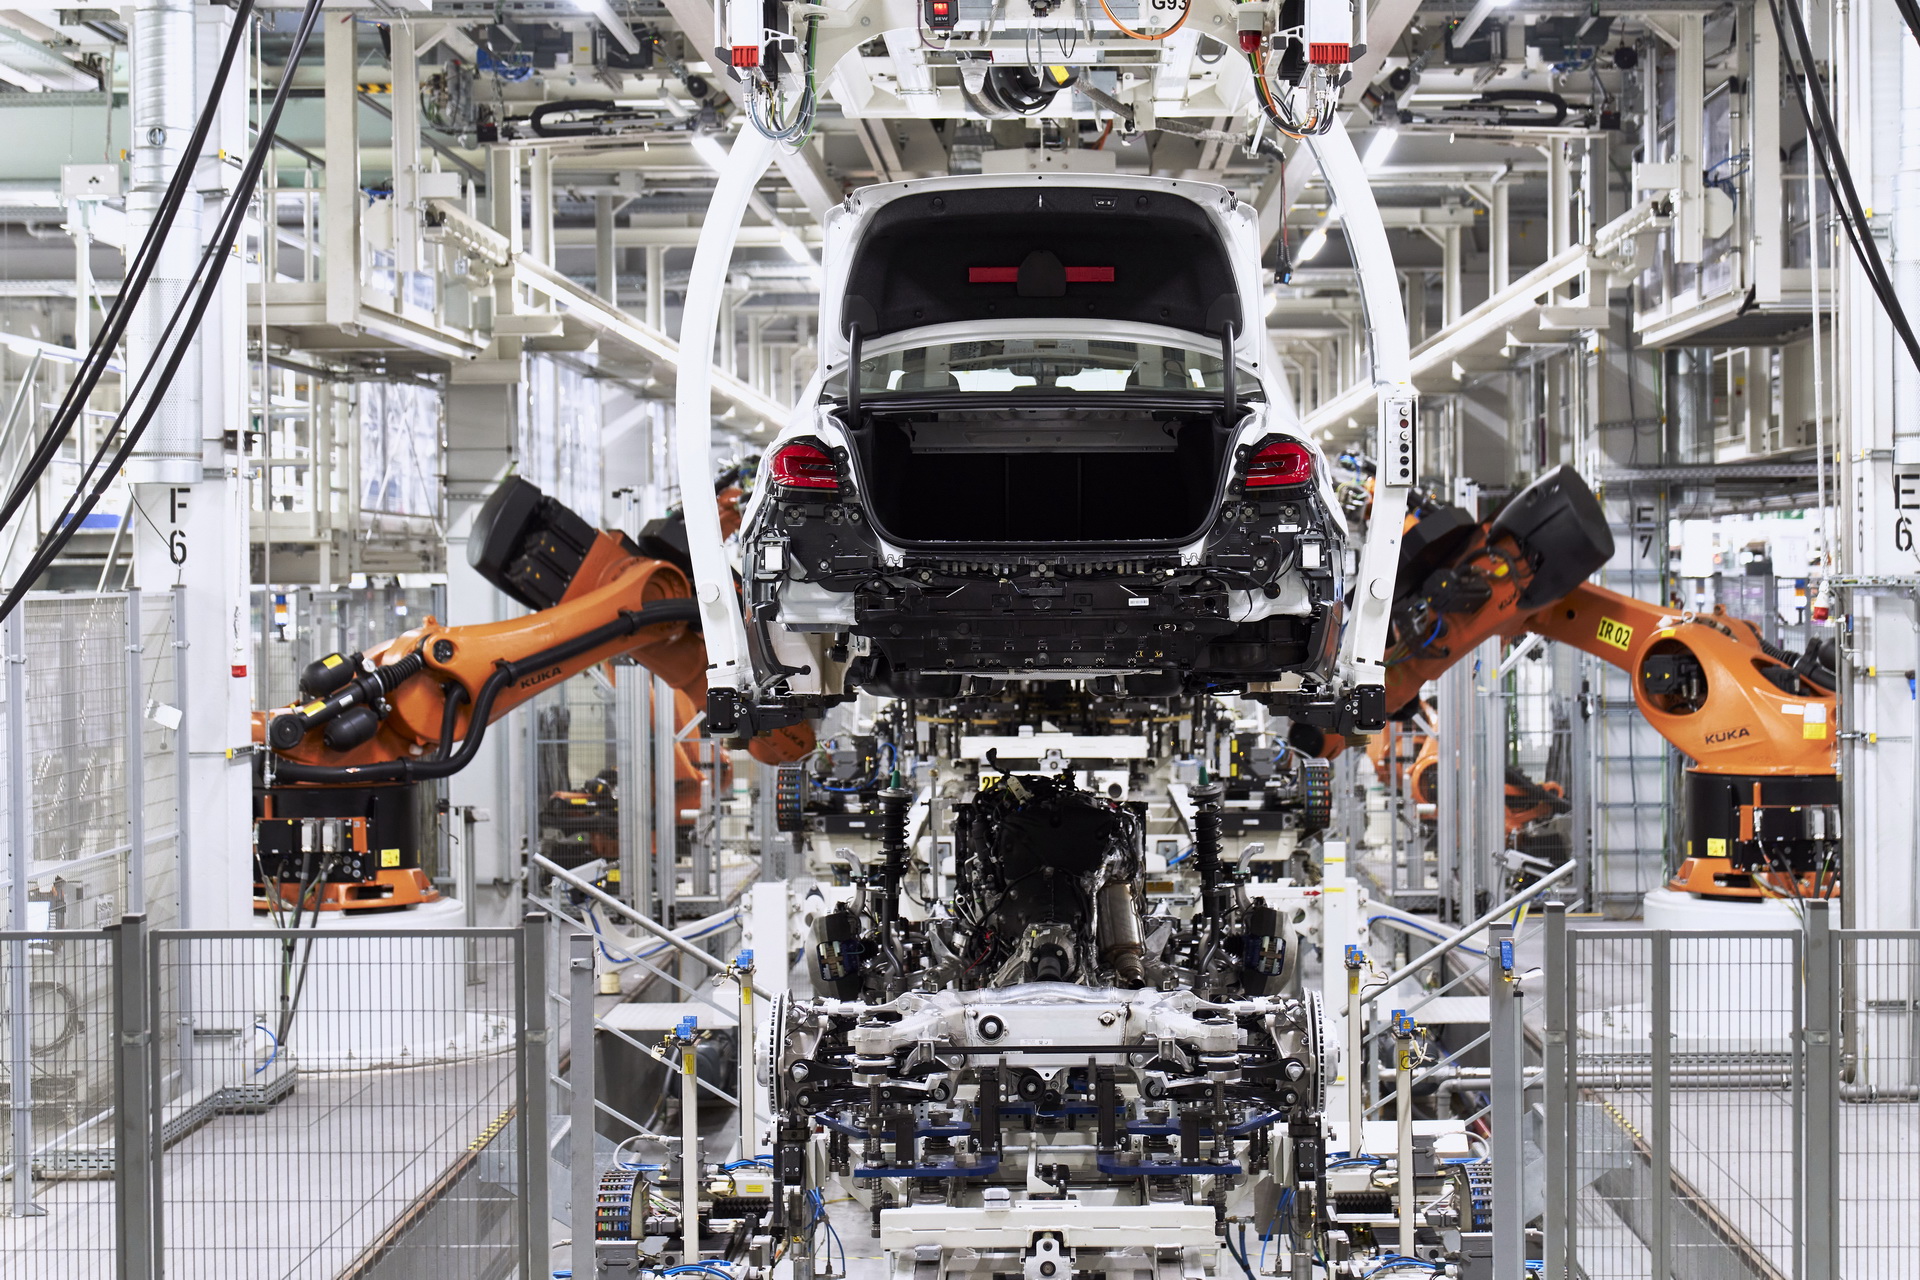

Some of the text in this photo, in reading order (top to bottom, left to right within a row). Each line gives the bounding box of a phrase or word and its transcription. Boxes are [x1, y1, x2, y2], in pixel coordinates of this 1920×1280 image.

[170, 487, 191, 524] F
[1895, 474, 1920, 509] E
[169, 529, 187, 565] 6
[1640, 534, 1653, 559] 7
[1895, 517, 1913, 552] 6
[1598, 619, 1630, 647] IR 02
[520, 666, 562, 689] KUKA
[1704, 727, 1750, 745] KUKA
